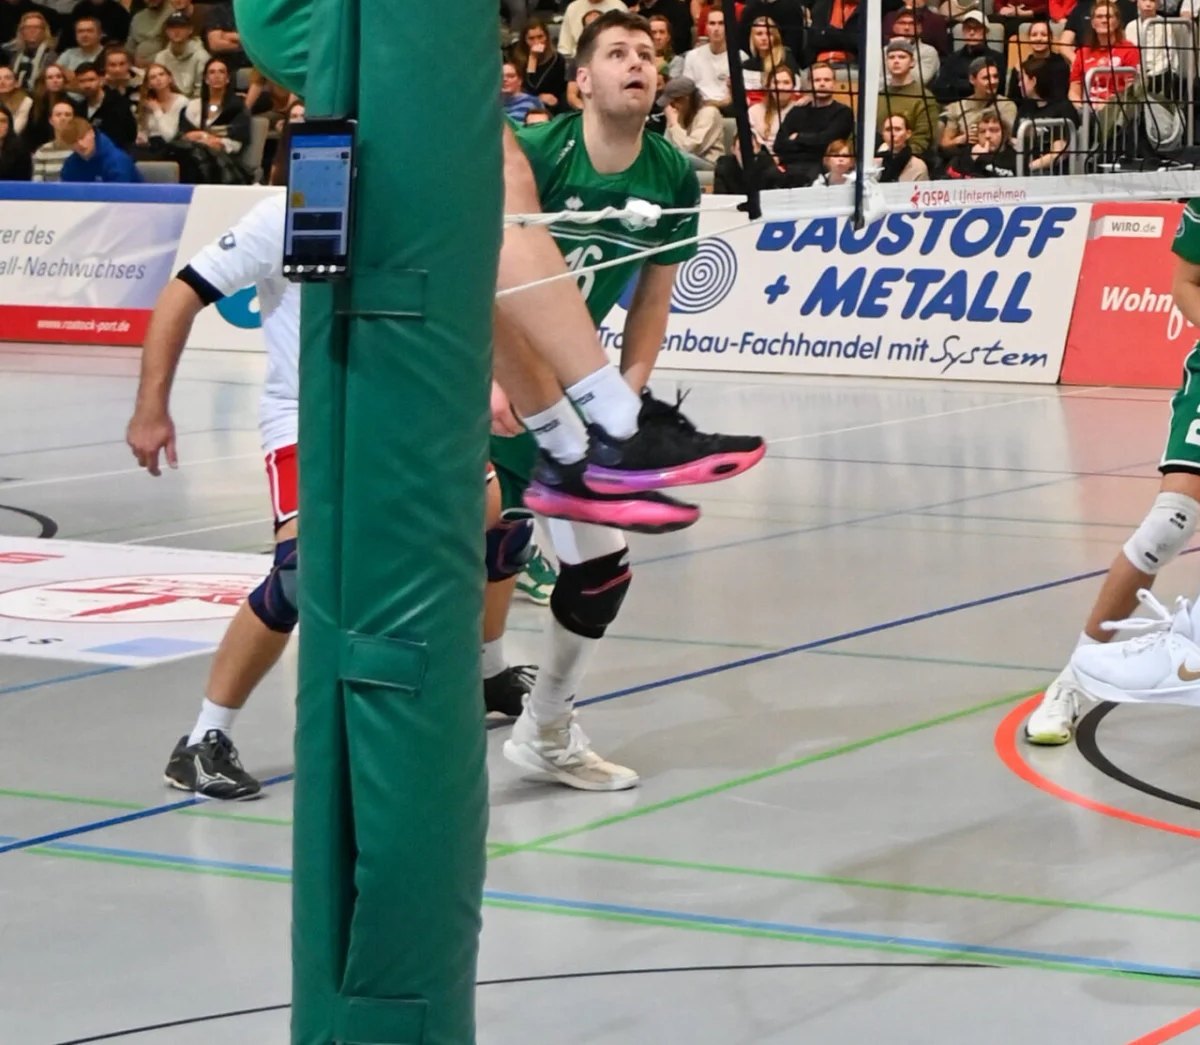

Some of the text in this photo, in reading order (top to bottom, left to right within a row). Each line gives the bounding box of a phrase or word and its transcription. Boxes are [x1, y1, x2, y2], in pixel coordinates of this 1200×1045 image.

[922, 190, 950, 206] OSPA
[959, 188, 1026, 204] Unternehmen
[24, 224, 55, 245] des
[756, 206, 1077, 258] BAUSTOFF
[1111, 221, 1156, 233] WIRO.de
[800, 266, 1032, 323] METALL
[596, 327, 1047, 374] Troenbau-Fachhandel mit System
